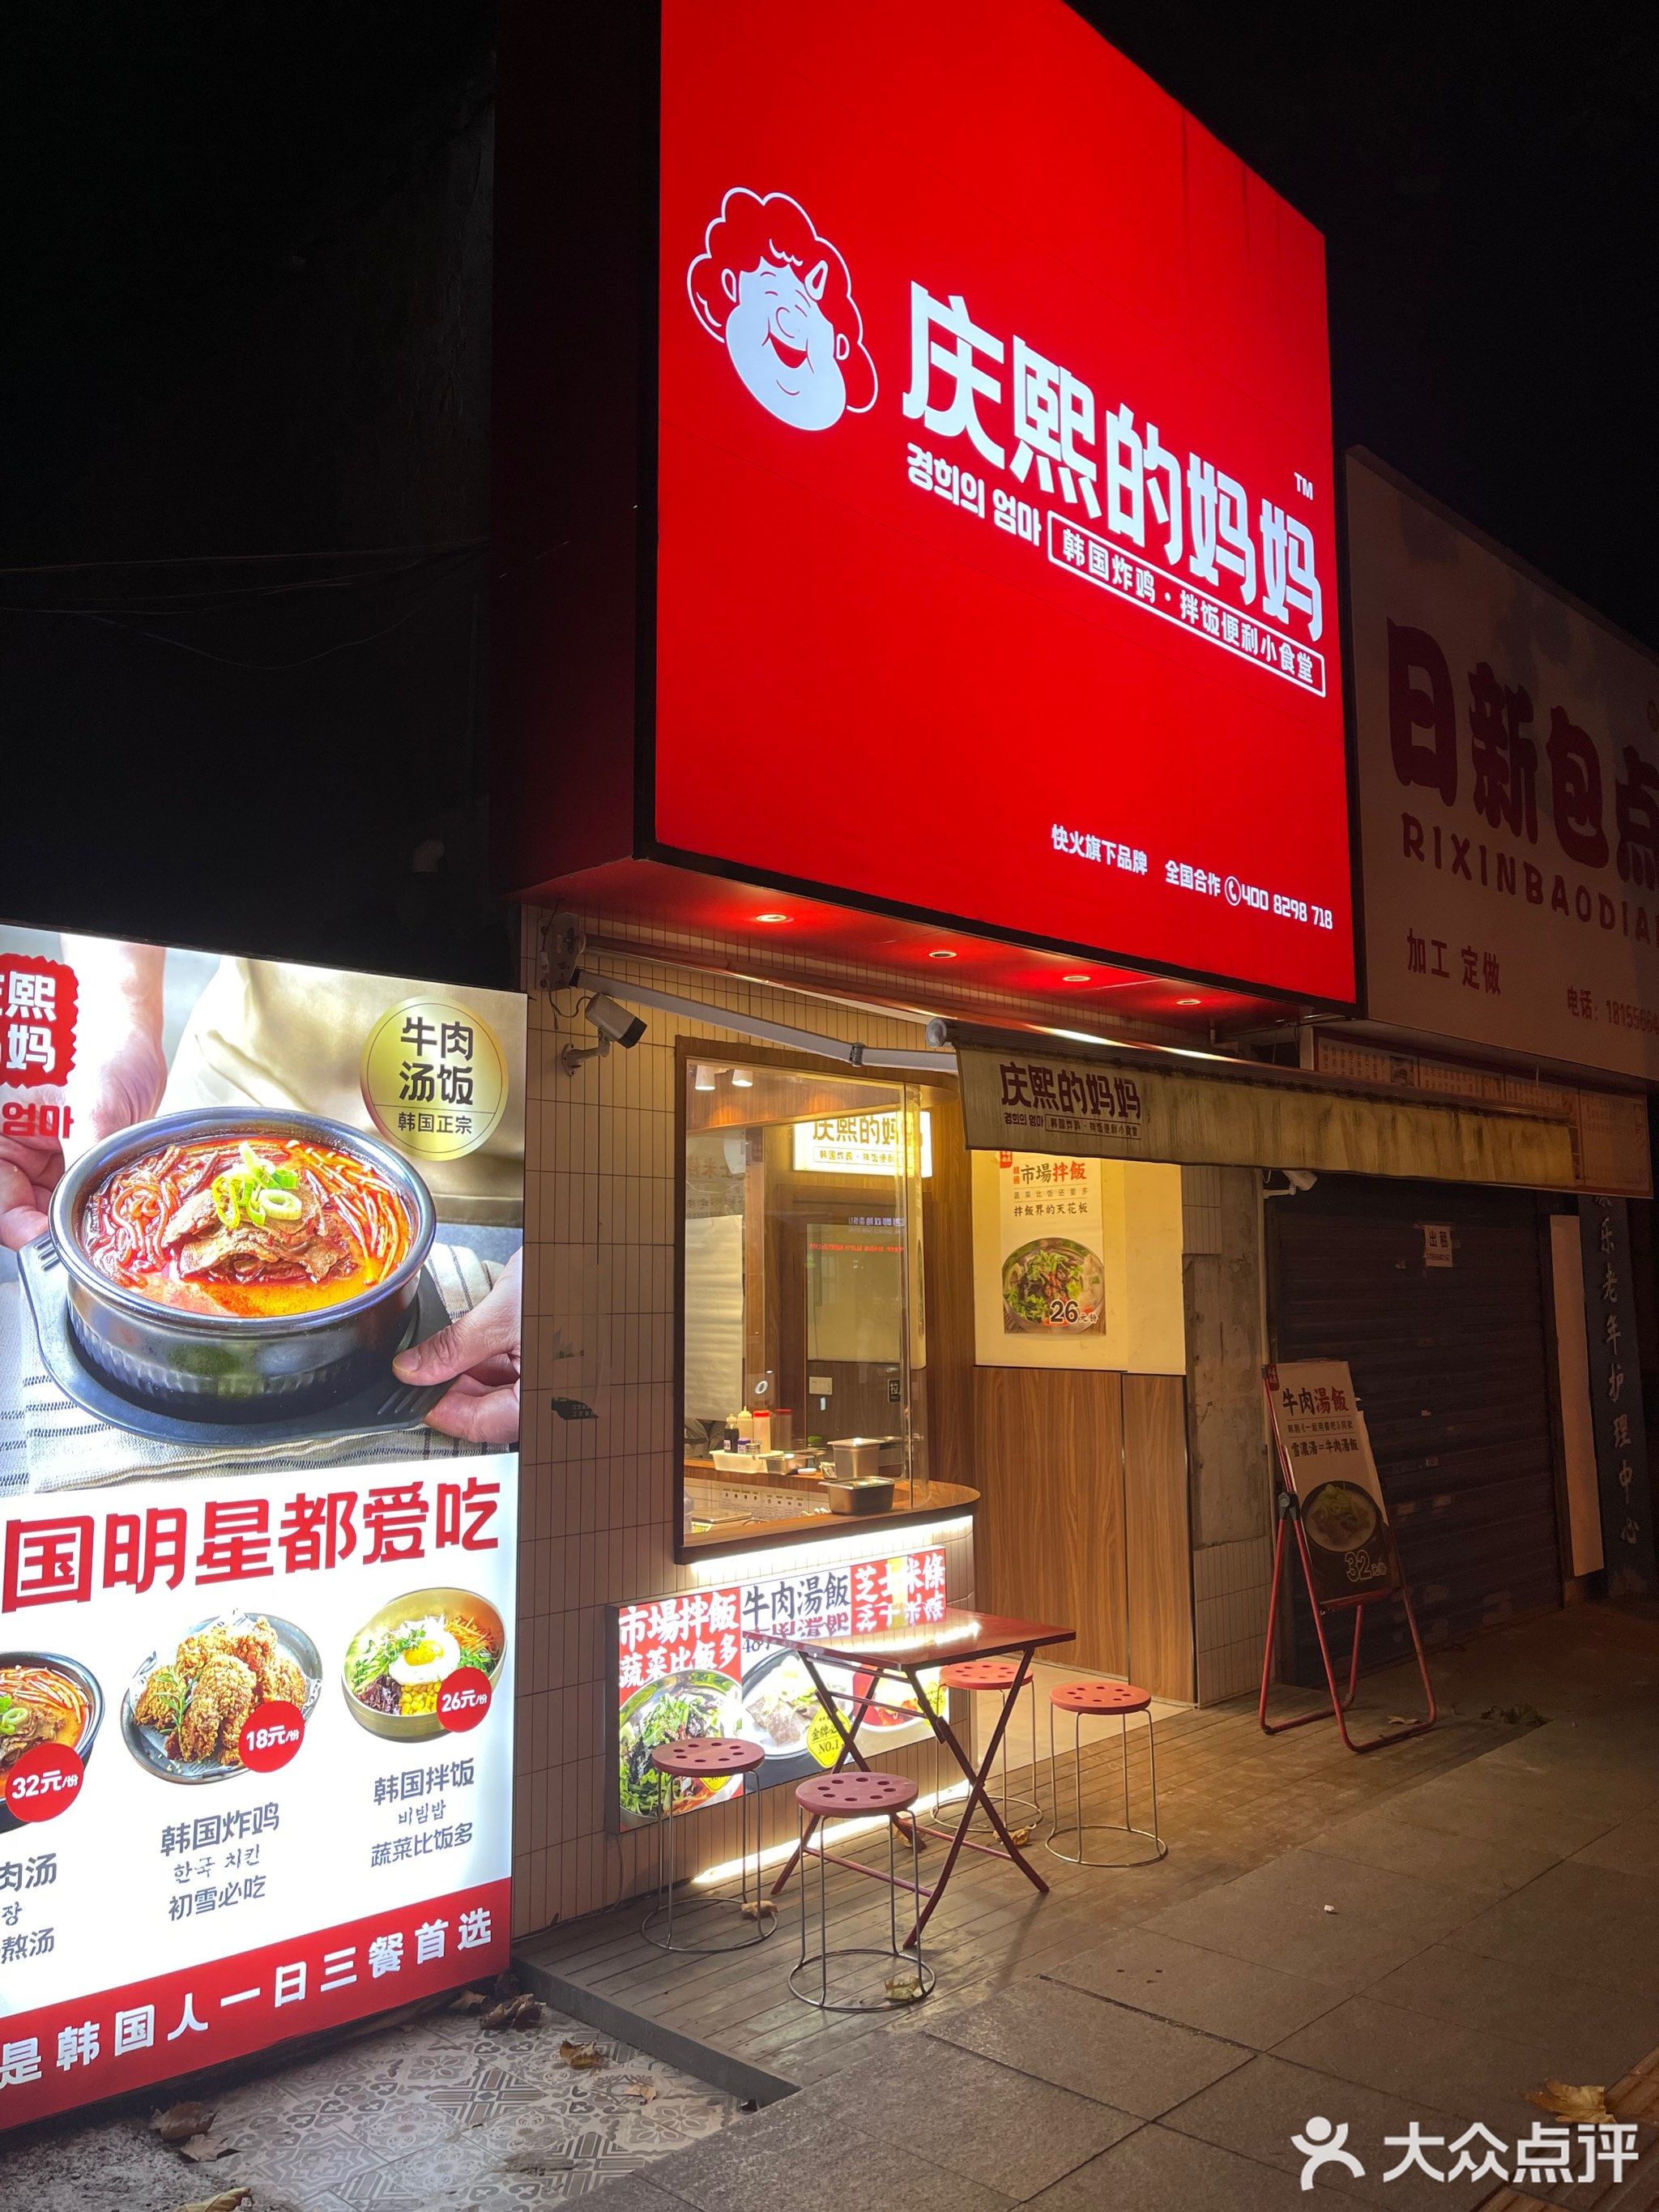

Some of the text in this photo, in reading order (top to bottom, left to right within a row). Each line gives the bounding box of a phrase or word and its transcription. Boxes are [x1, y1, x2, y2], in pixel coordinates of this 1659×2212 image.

[902, 280, 1324, 642] 庆熙的妈妈
[1294, 472, 1314, 501] TM
[906, 442, 1042, 549] 경희의 엄마
[1062, 527, 1314, 685] 韩国炸鸡·拌饭便利小食堂
[1051, 823, 1333, 930] 快火旗下品牌 全国合作 400 8298 718
[1401, 812, 1659, 947] RIXINBAODIA
[1406, 928, 1501, 997] 加工 定做
[0, 971, 57, 1022] 熙
[400, 1016, 474, 1061] 牛肉
[399, 1061, 475, 1107] 汤饭
[1000, 1061, 1141, 1120] 庆熙的妈妈
[397, 1111, 473, 1134] 韩国正宗
[2, 1476, 501, 1613] 国明星都爱吃
[619, 1591, 740, 1653] 市場拌飯
[742, 1571, 851, 1628] 牛肉湯飯
[373, 1757, 476, 1807] 韩国拌饭
[160, 1801, 279, 1857] 韩国炸鸡
[398, 1800, 446, 1826] 비빔밥
[174, 1844, 261, 1884] 한국 치킨
[371, 1822, 474, 1868] 蔬菜比饭多
[168, 1875, 267, 1922] 初雪必吃
[0, 1907, 493, 2090] 是韩国人一日三餐首选
